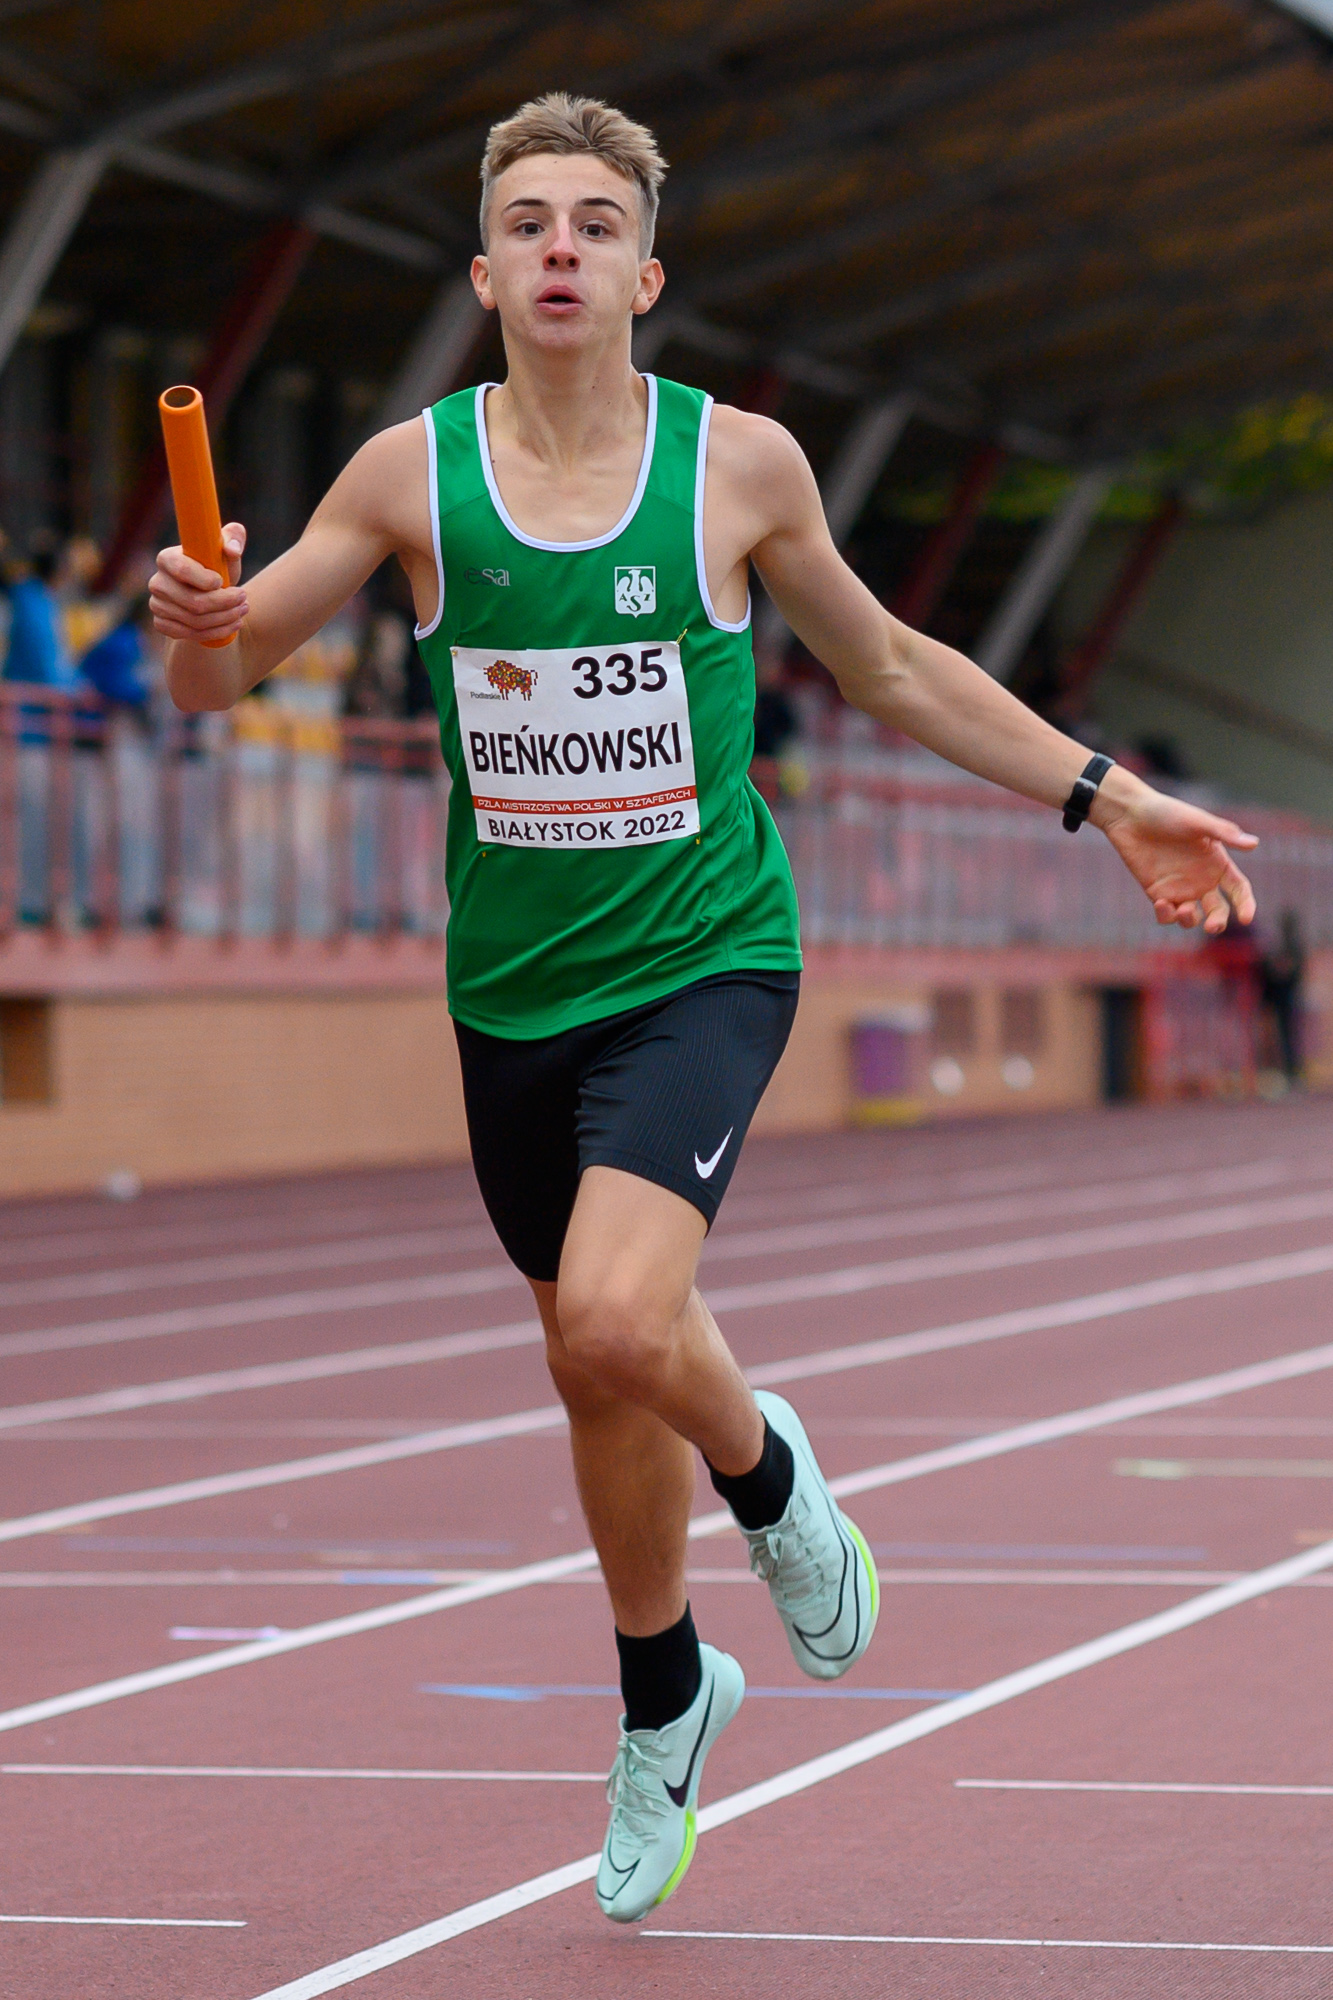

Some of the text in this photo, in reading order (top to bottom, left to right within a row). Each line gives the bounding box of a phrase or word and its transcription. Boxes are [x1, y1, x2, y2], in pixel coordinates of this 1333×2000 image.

[571, 648, 668, 699] 335
[469, 722, 682, 776] BIEŃKOWSKI
[478, 789, 691, 811] PZLA MISTRZOSTWA POLSKI W SZTAFETACH
[488, 810, 686, 842] BIAŁYSTOK 2022
